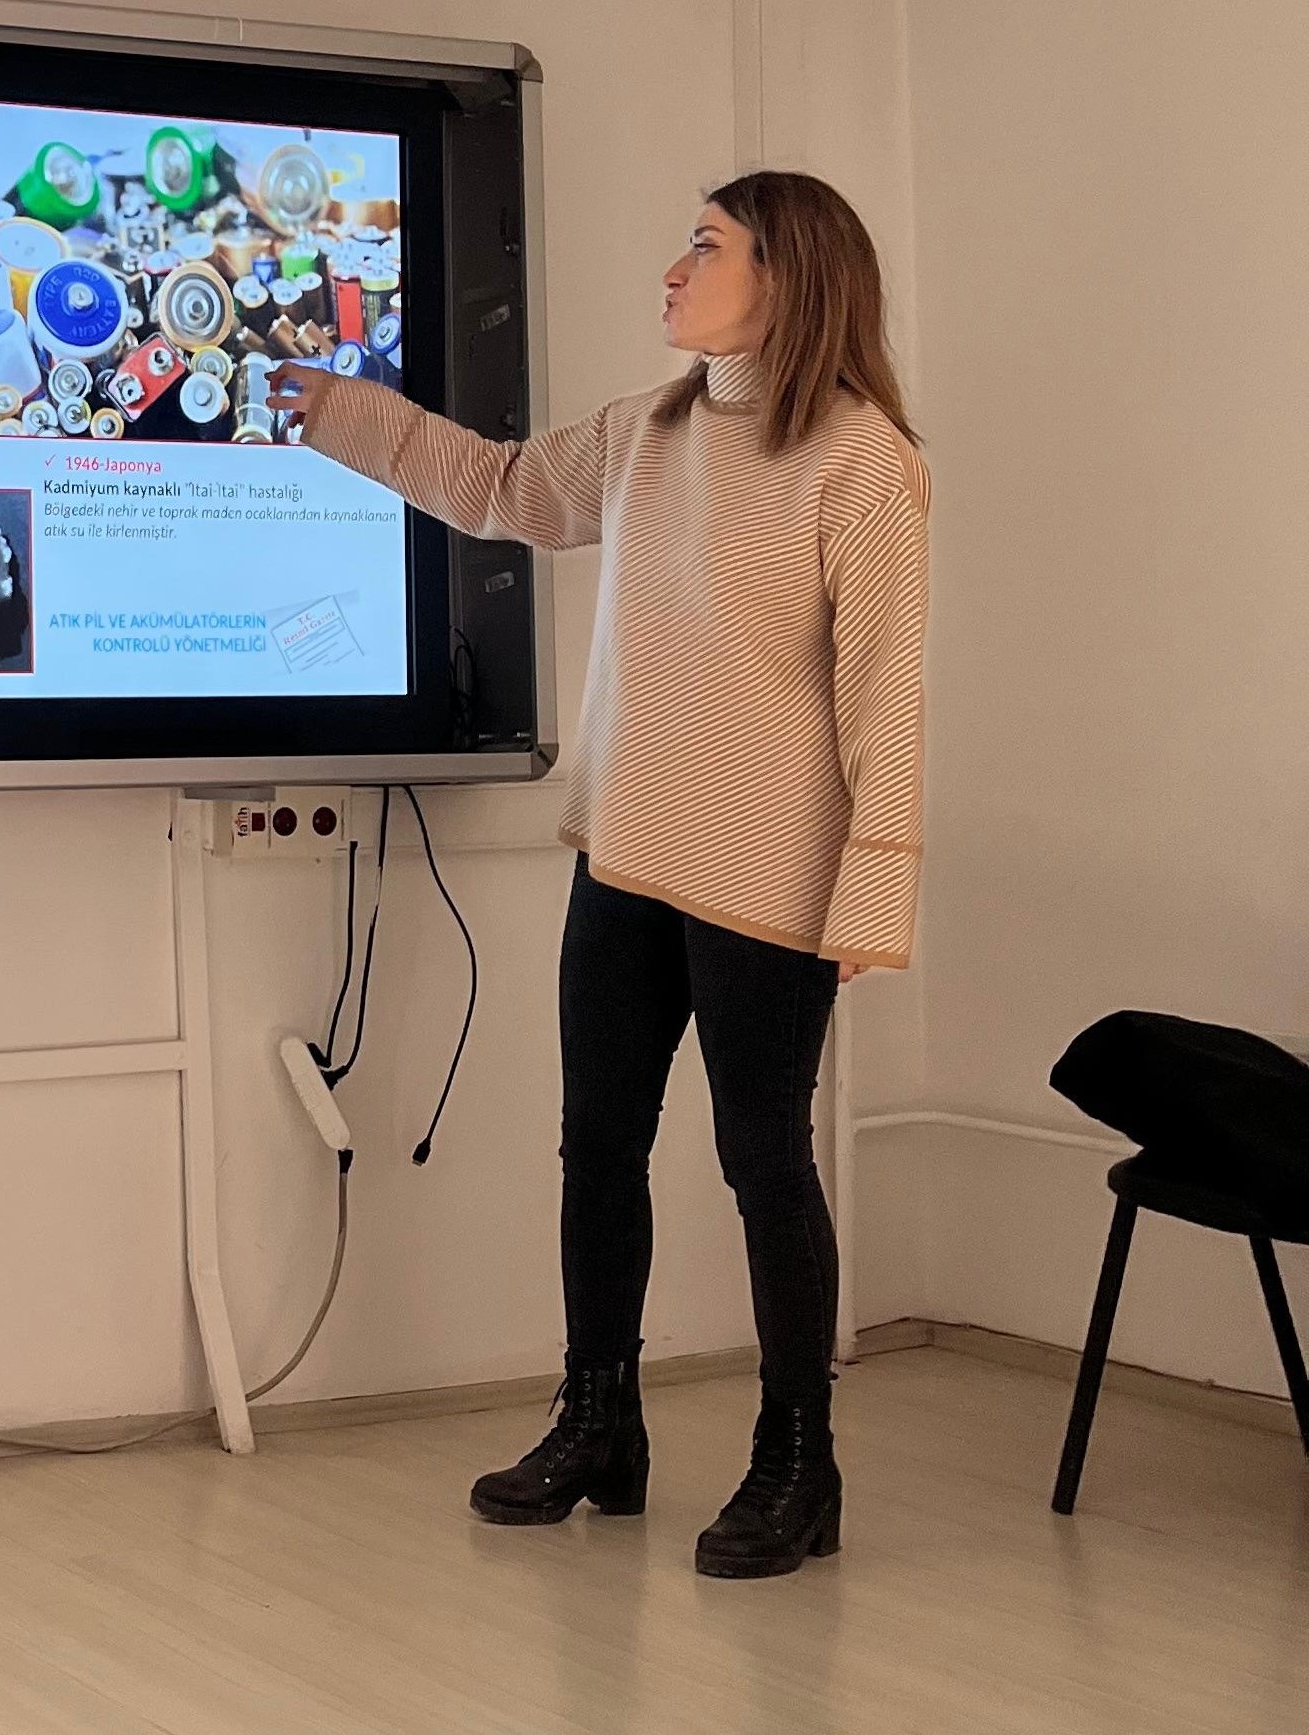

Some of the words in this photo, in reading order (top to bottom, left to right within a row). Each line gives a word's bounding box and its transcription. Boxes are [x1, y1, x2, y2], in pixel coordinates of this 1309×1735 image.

[65, 456, 162, 475] 1946-Japonya
[44, 480, 120, 499] Kadmiyum
[123, 480, 181, 499] kaynaklı
[249, 483, 303, 502] hastalığı
[44, 503, 105, 519] Bölgedeki
[107, 506, 139, 518] nehir
[142, 508, 156, 518] ve
[159, 508, 198, 521] toprak
[201, 508, 241, 519] maden
[245, 507, 321, 521] ocaklarından
[324, 508, 397, 523] kaynaklanan
[44, 525, 68, 537] atık
[70, 527, 85, 537] su
[88, 524, 103, 538] ile
[105, 525, 178, 540] kirlenmiştir.
[49, 614, 81, 628] ATIK
[85, 612, 104, 628] PİL
[108, 614, 126, 628] VE
[130, 612, 267, 629] AKÜMÜLATÖRLERİN
[93, 636, 171, 652] KONTROLÜ
[174, 635, 267, 652] YÖNETMELİĞİ
